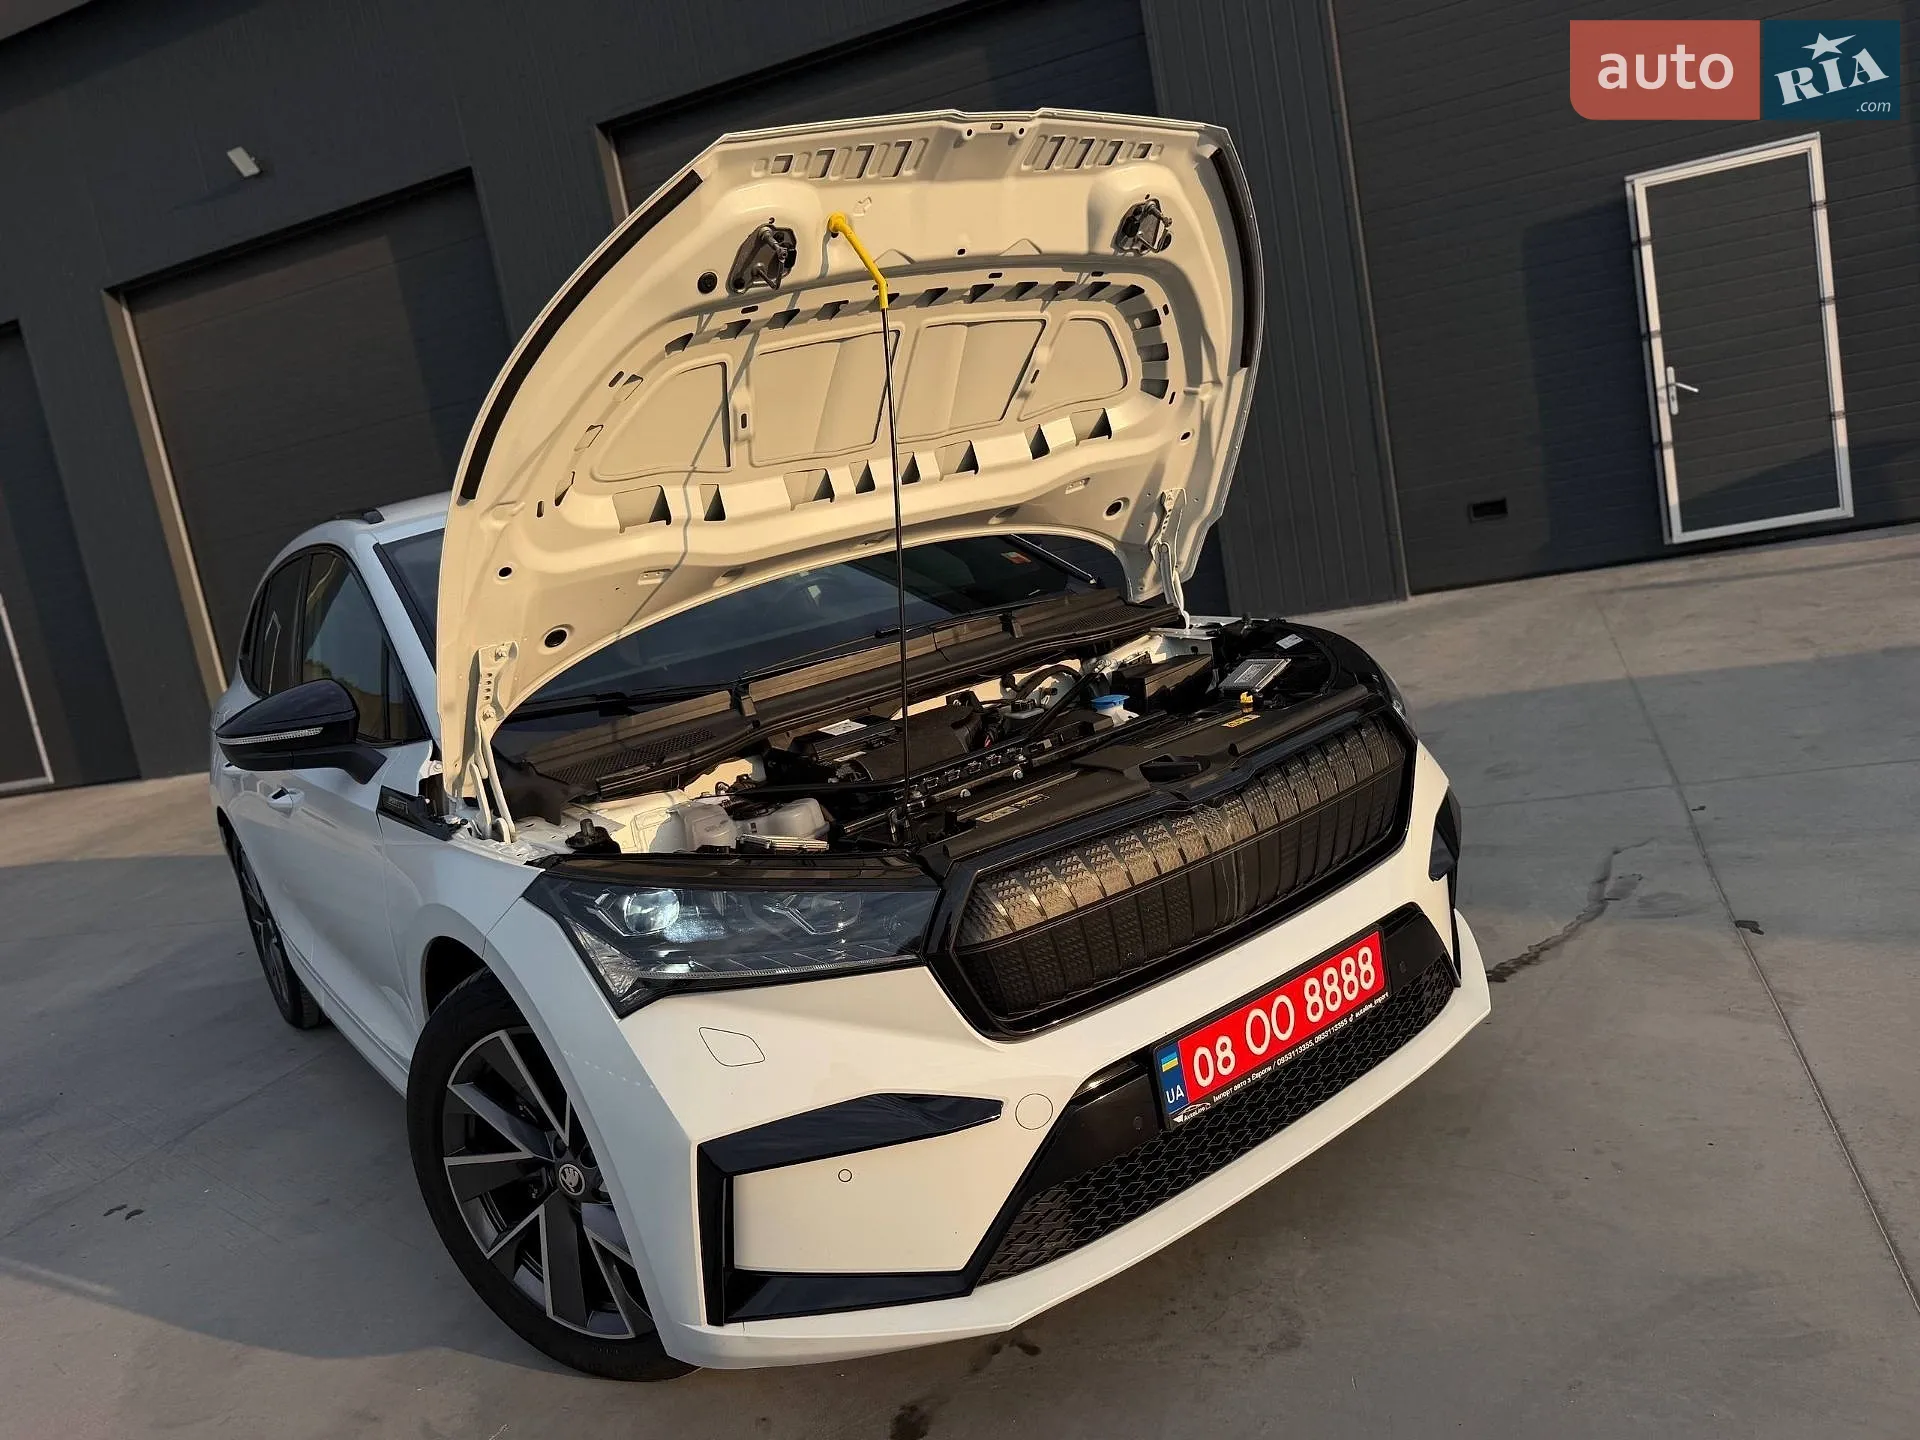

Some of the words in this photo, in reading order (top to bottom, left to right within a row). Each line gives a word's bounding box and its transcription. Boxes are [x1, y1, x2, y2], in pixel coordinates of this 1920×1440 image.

[1193, 1035, 1236, 1088] 08
[1303, 946, 1376, 1023] 8888
[1166, 1084, 1185, 1104] UA
